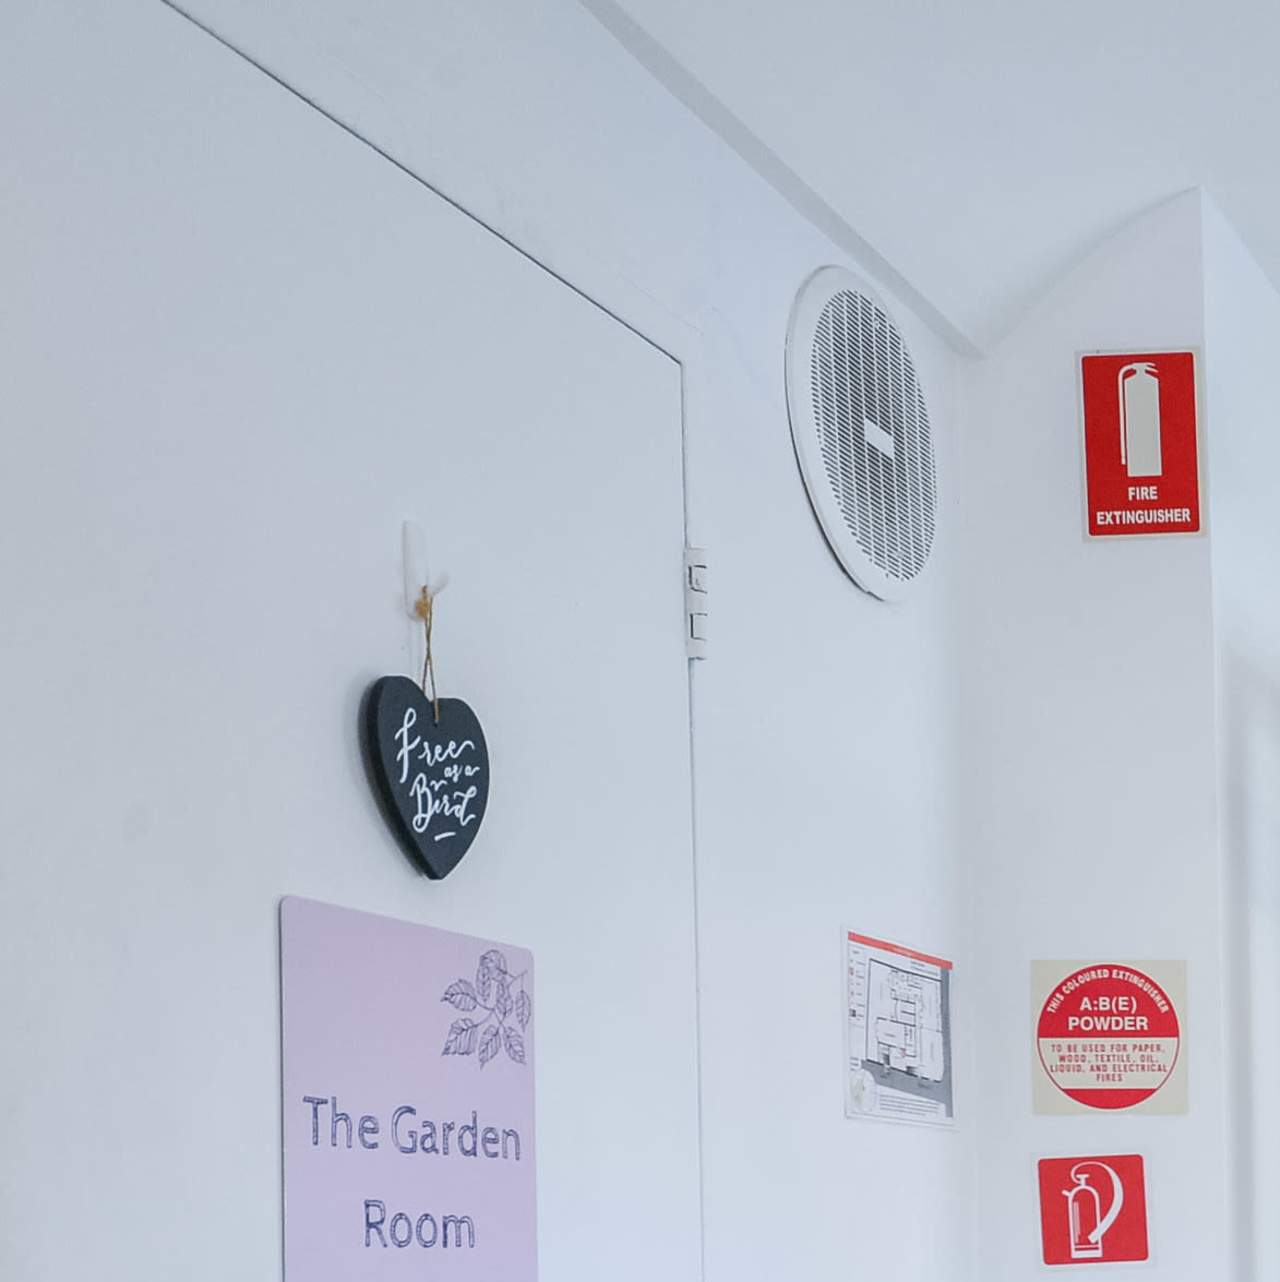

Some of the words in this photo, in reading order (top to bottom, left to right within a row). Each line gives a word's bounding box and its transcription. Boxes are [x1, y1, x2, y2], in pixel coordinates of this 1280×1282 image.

[1128, 486, 1158, 501] FIRE
[1096, 508, 1192, 525] EXTINGUISHER
[394, 708, 475, 783] Free
[410, 773, 477, 832] Bird
[1047, 993, 1064, 1013] THIS
[1062, 969, 1110, 994] COLOURED
[1112, 969, 1169, 1013] EXTINGUISHER
[1080, 996, 1137, 1014] A:B(E)
[1068, 1016, 1148, 1031] POWDER
[1051, 1044, 1062, 1053] TO
[1067, 1044, 1077, 1053] BE
[1082, 1044, 1106, 1053] USED
[1110, 1044, 1128, 1053] FOR
[1089, 1064, 1108, 1073] AND
[1112, 1064, 1168, 1073] ELECTRICAL
[1096, 1073, 1123, 1082] FIRES
[303, 1096, 380, 1149] The
[391, 1105, 521, 1161] Garden
[363, 1199, 476, 1248] Room
